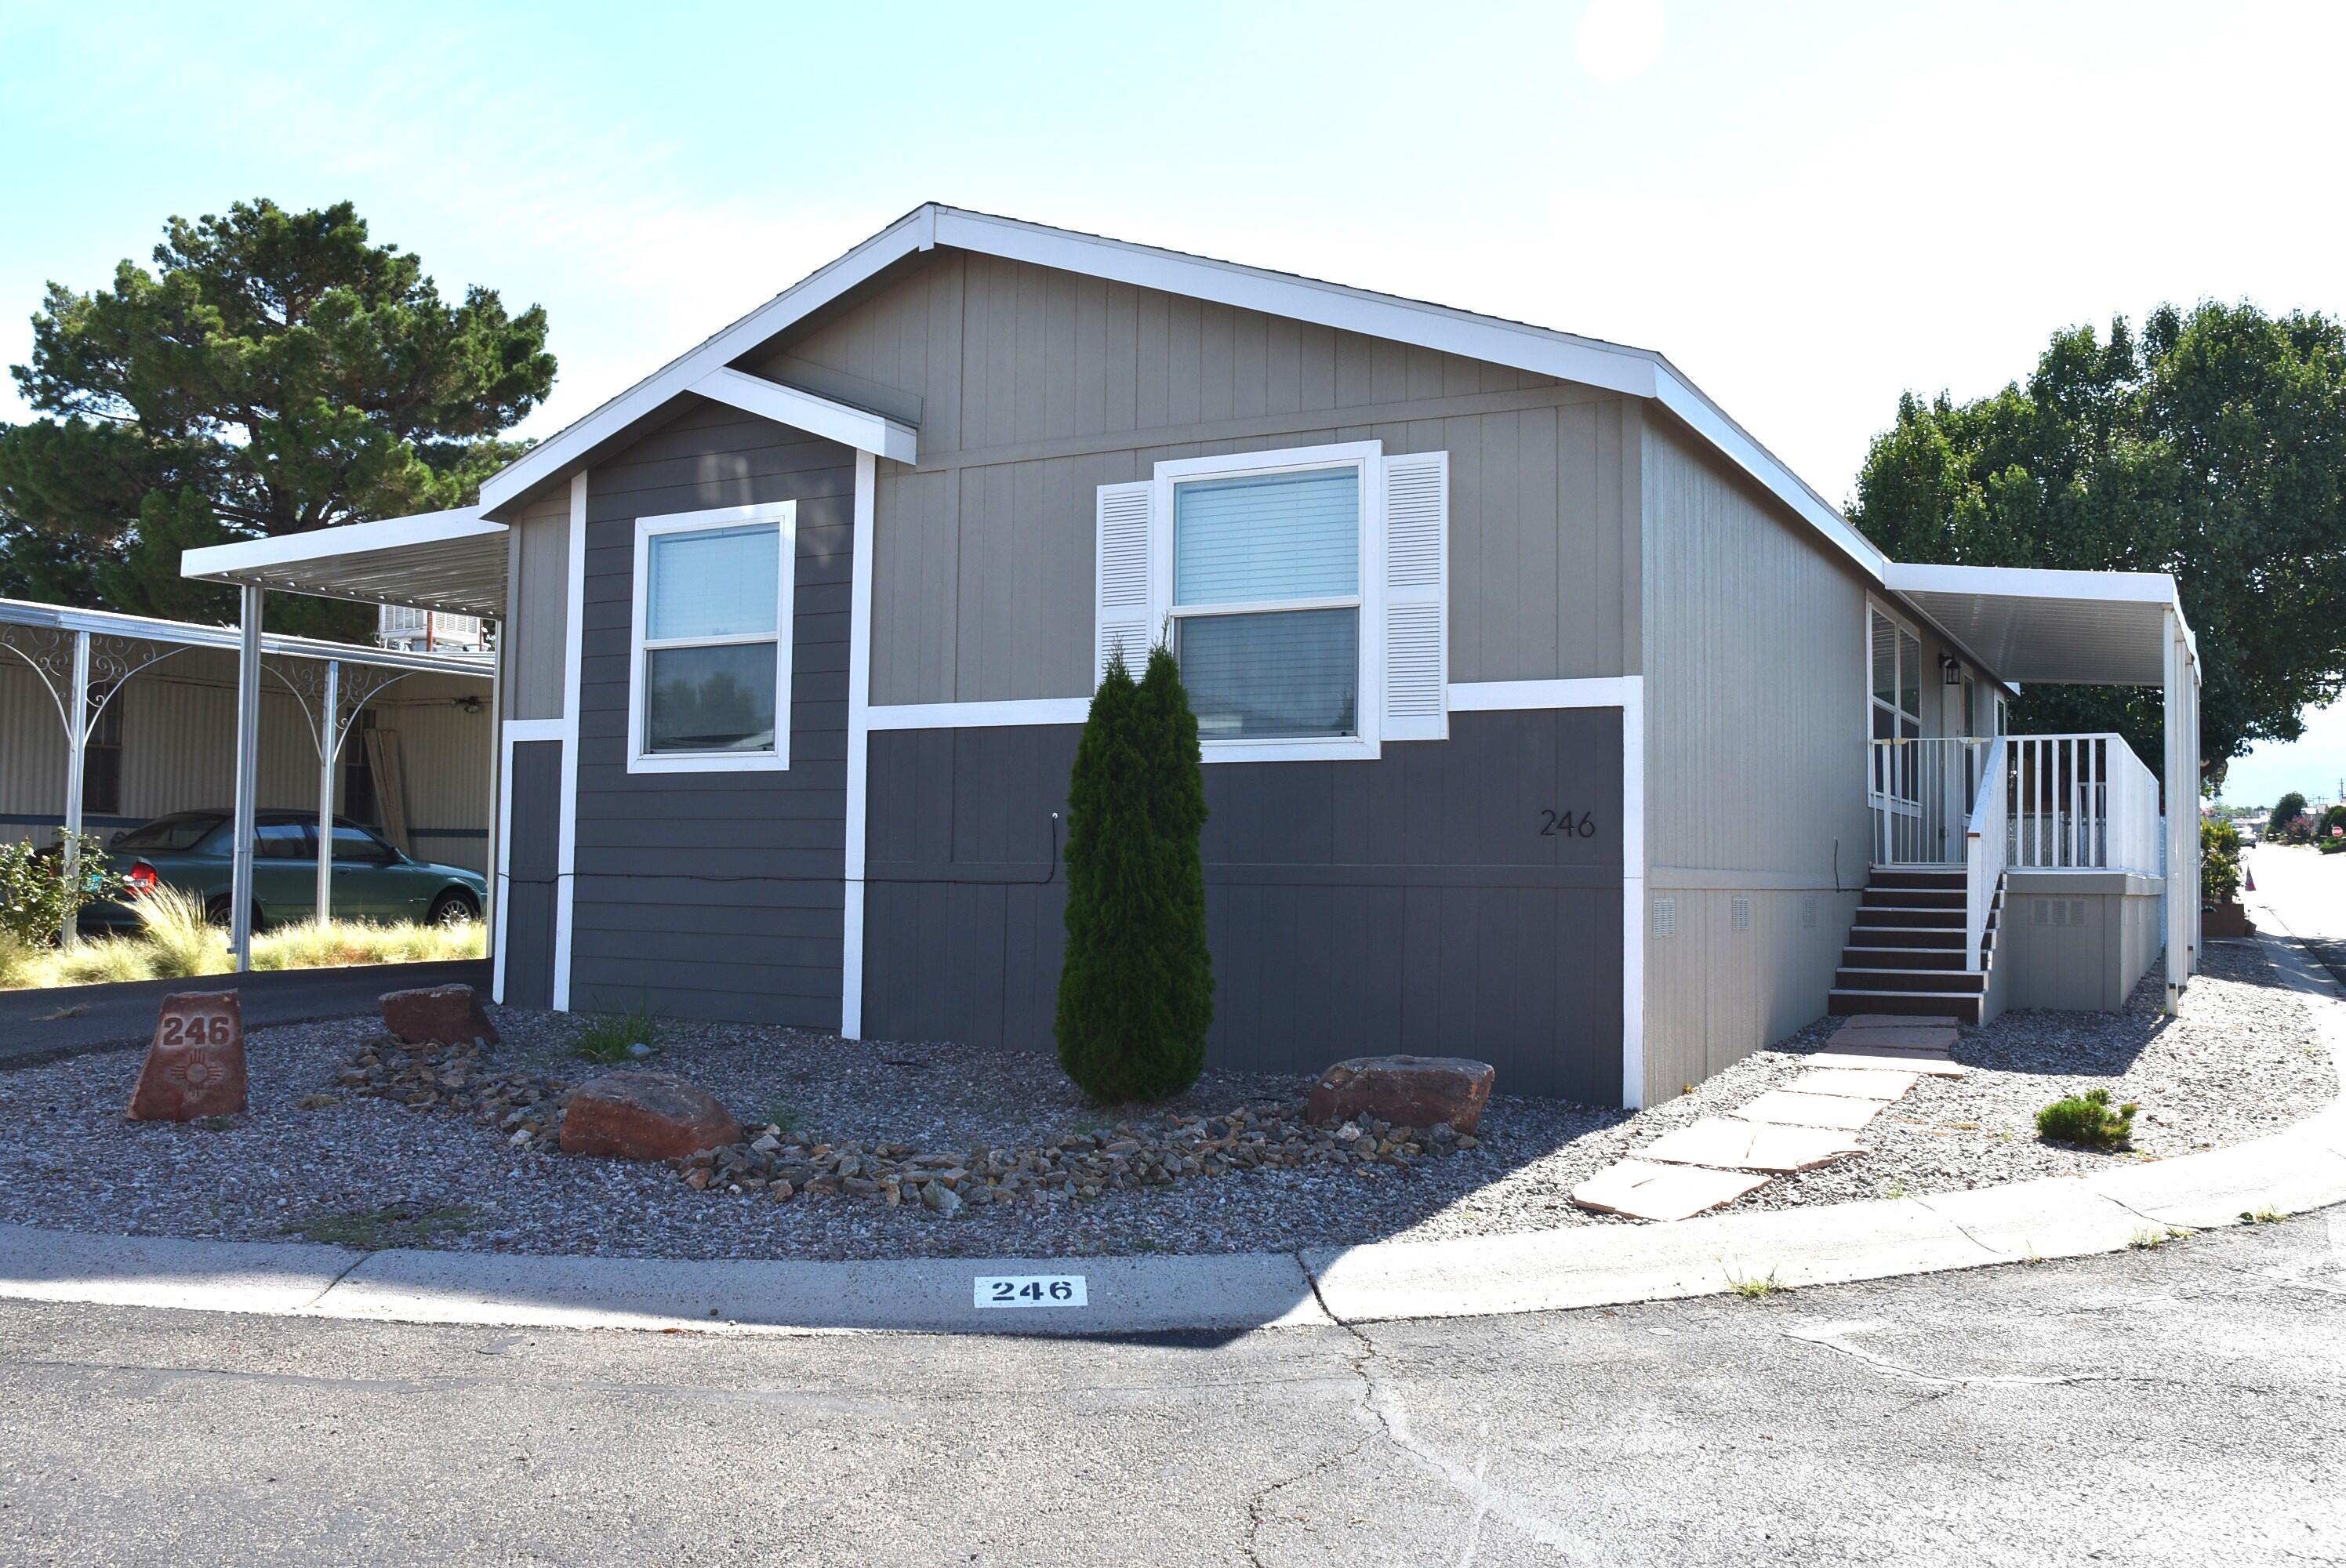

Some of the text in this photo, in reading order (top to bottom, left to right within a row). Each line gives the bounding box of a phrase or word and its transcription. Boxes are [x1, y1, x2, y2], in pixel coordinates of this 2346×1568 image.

[1540, 809, 1595, 838] 246
[163, 1017, 230, 1046] 246
[992, 1281, 1073, 1301] 246
